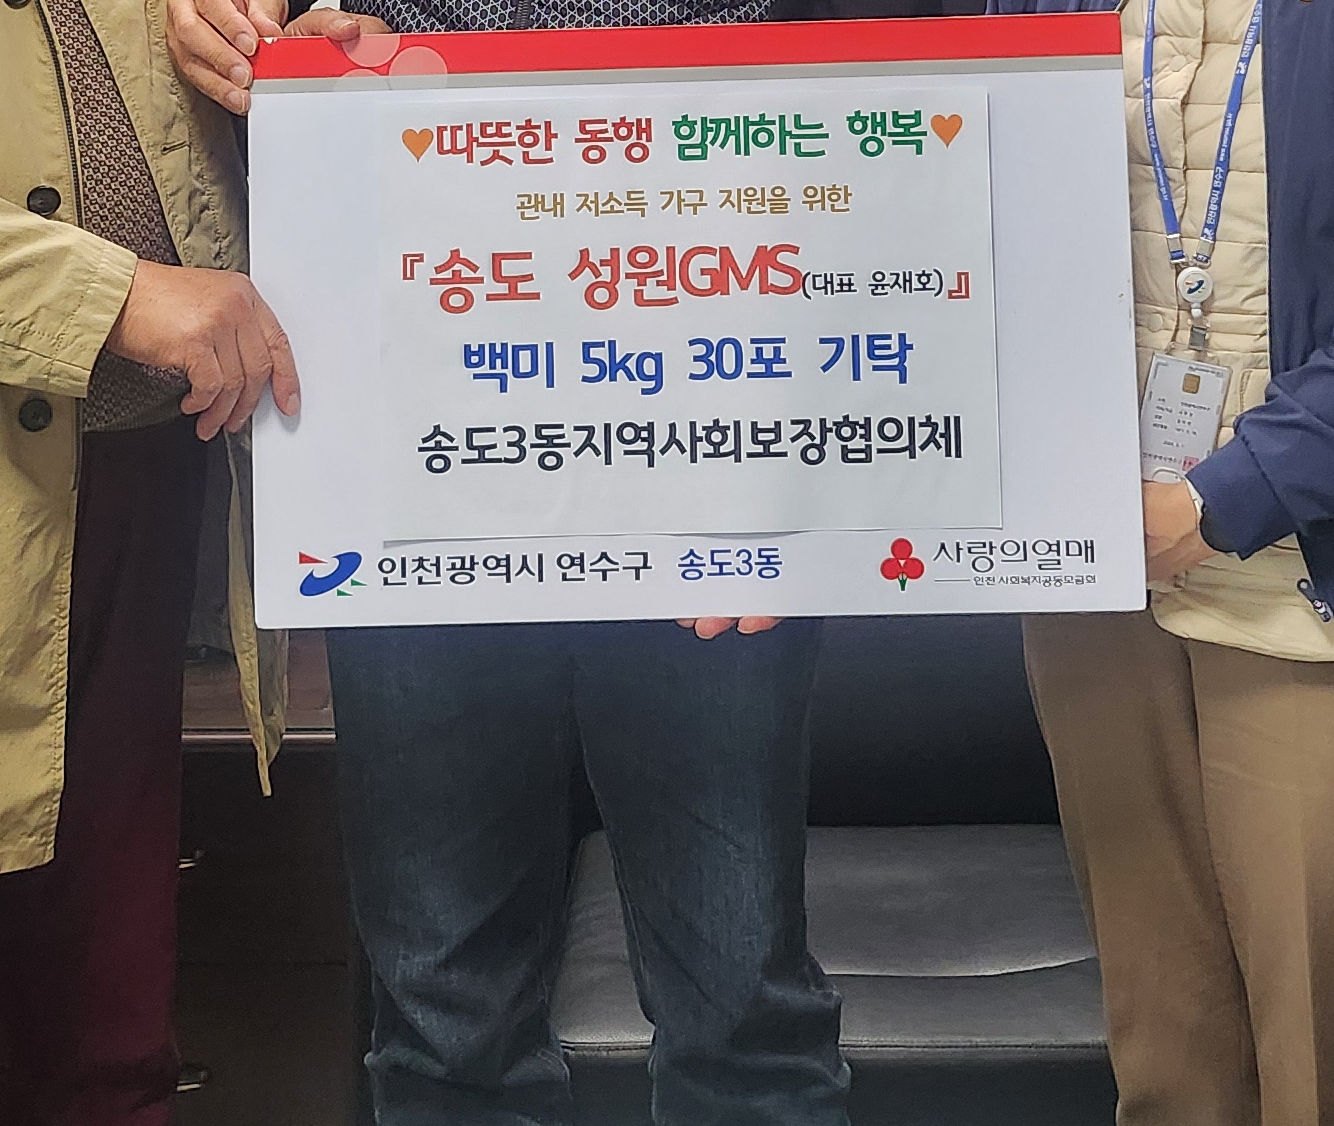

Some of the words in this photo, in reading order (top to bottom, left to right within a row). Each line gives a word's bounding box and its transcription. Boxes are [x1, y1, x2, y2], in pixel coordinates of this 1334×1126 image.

[437, 118, 558, 166] 따뜻한
[575, 116, 652, 164] 동행
[672, 113, 829, 161] 함께하는
[846, 109, 925, 158] 행복
[516, 191, 565, 220] 관내
[576, 190, 648, 217] 저소득
[660, 190, 708, 215] 가구
[719, 186, 791, 214] 지원을
[802, 184, 852, 212] 위한
[464, 342, 554, 393] 백미
[581, 340, 663, 395] 5kg
[688, 337, 792, 380] 30포
[819, 333, 914, 384] 기탁
[418, 414, 962, 474] 송도3동지역사회보장협의체
[378, 553, 543, 586] 인천광역시
[556, 552, 652, 582] 연수구
[678, 548, 782, 580] 송도3동
[932, 539, 1095, 573] 사랑의열매
